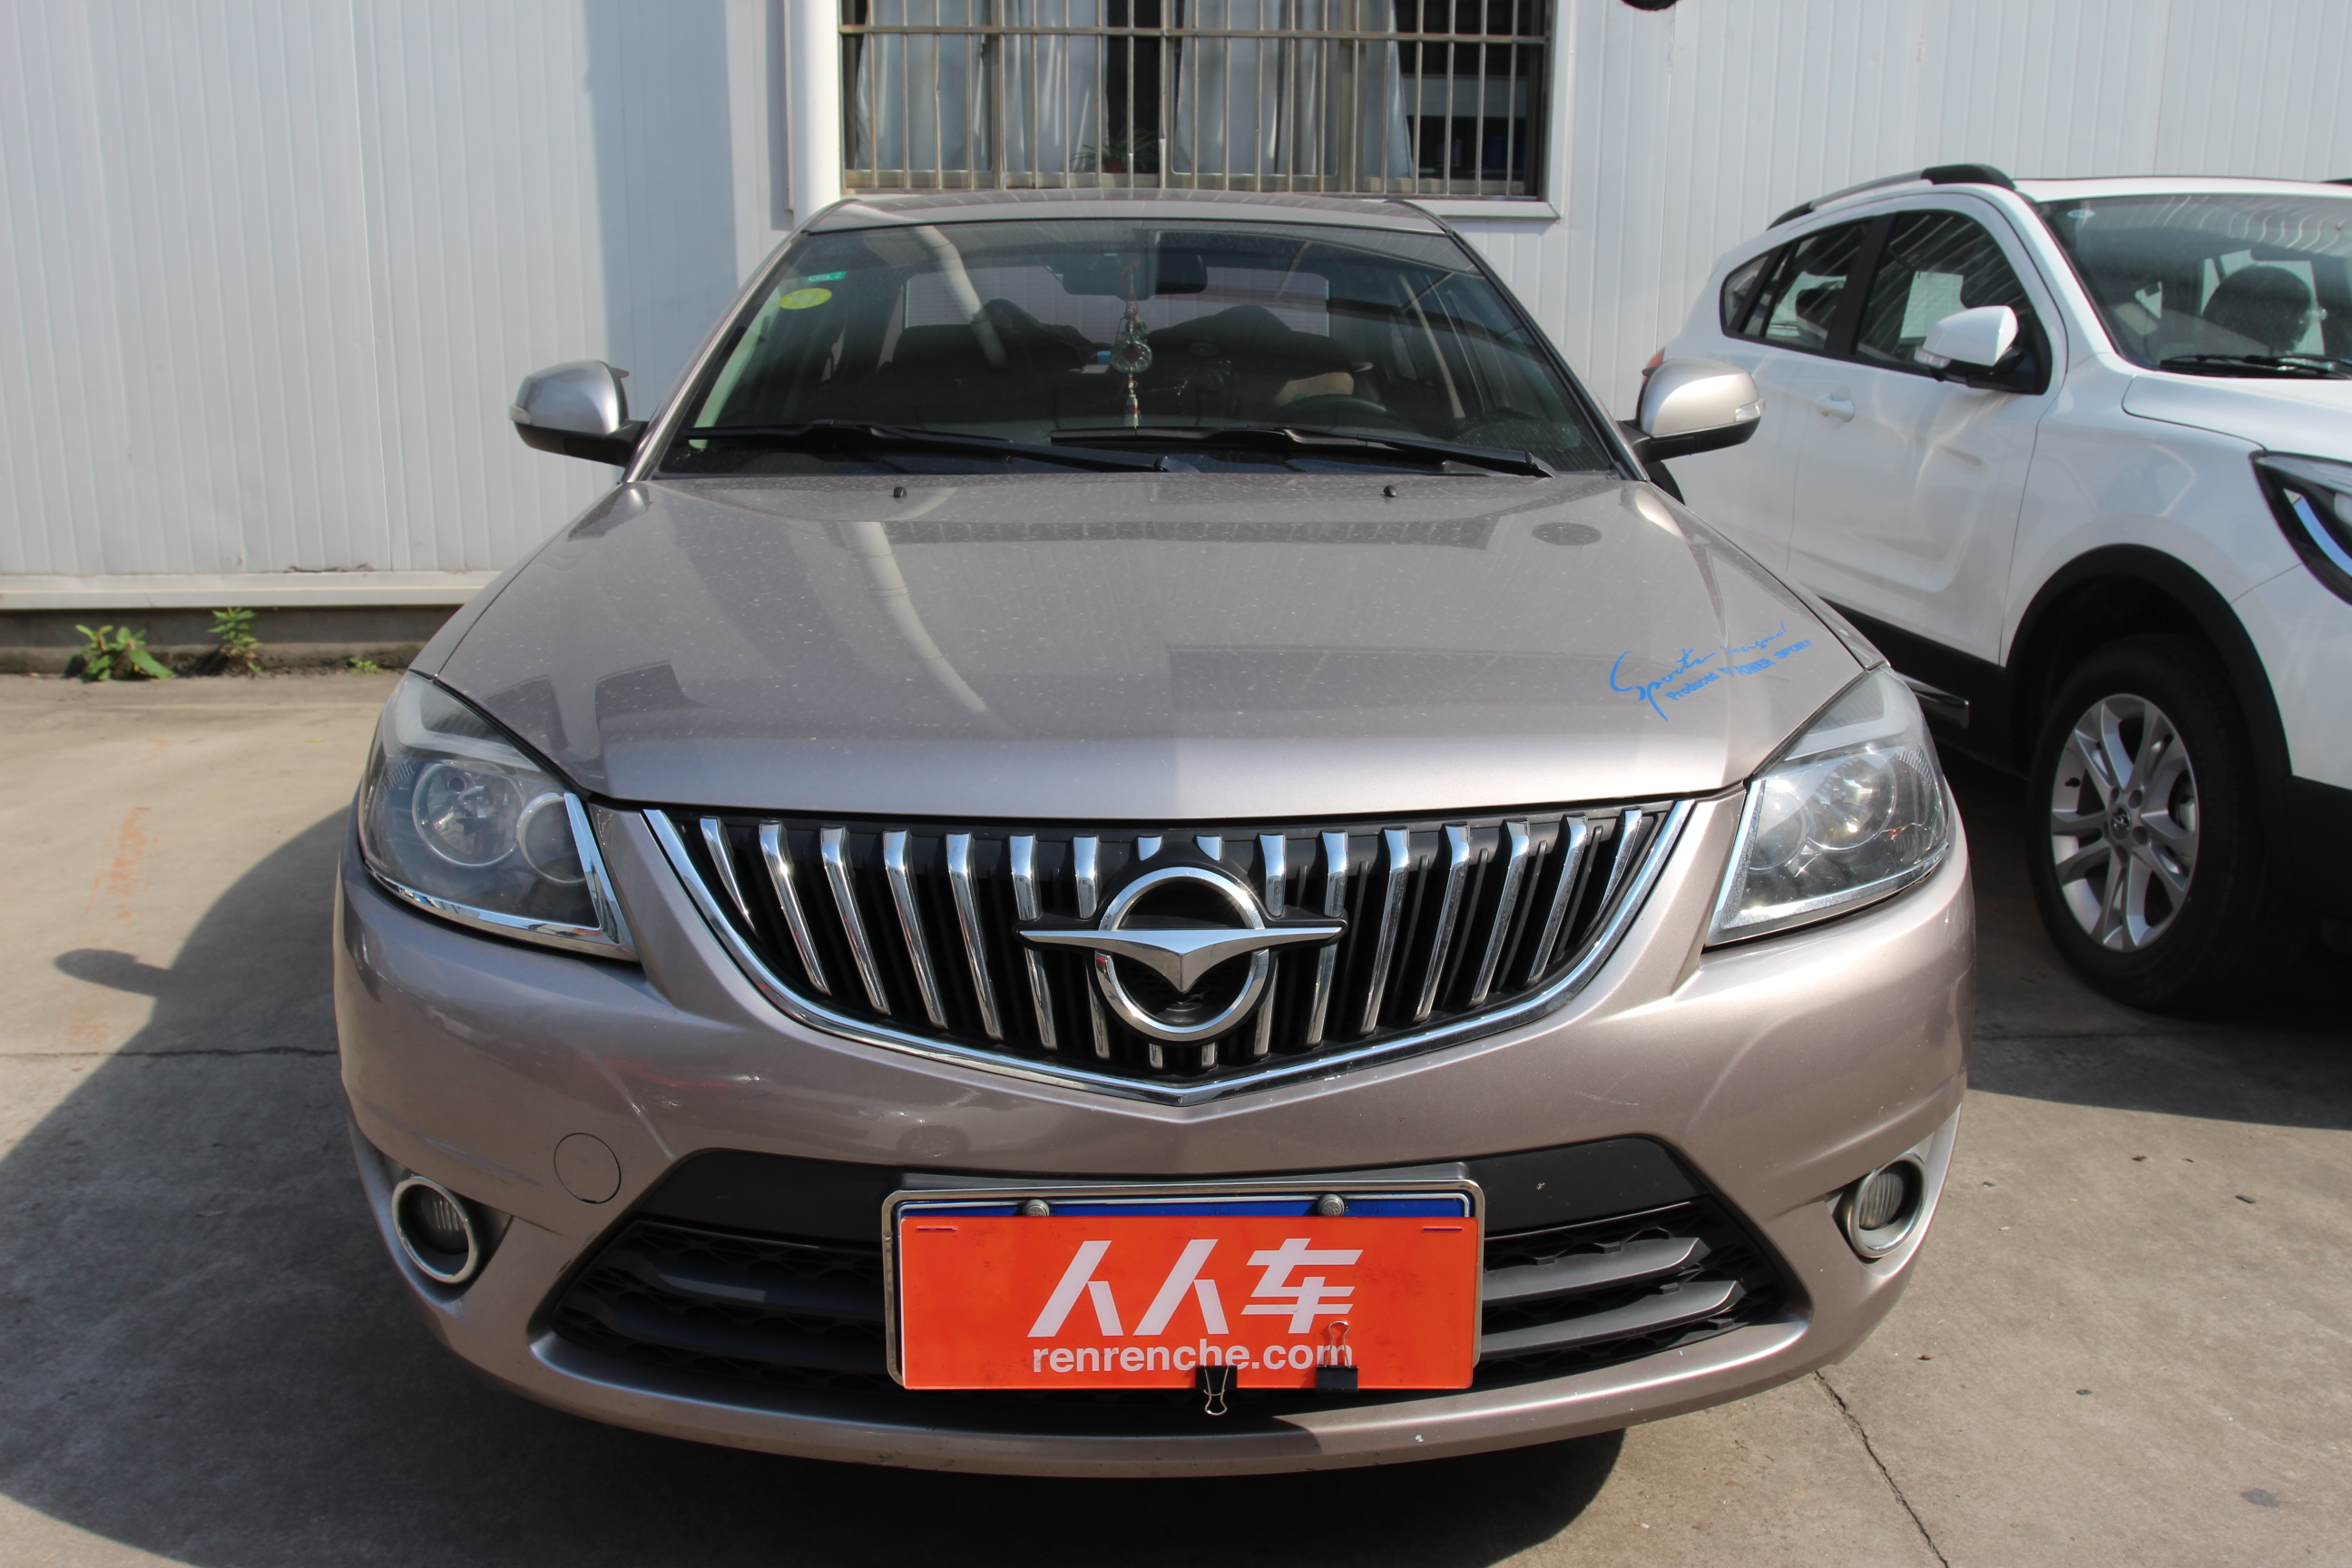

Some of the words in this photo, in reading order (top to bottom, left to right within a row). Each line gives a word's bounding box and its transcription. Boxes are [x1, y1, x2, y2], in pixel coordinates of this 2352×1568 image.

[1609, 648, 1717, 721] Sports
[1664, 671, 1721, 701] Produced
[1733, 657, 1777, 677] POWER
[1773, 638, 1814, 660] SPORT
[1026, 1237, 1364, 1338] 人人车
[1033, 1338, 1354, 1373] renrenche.com
